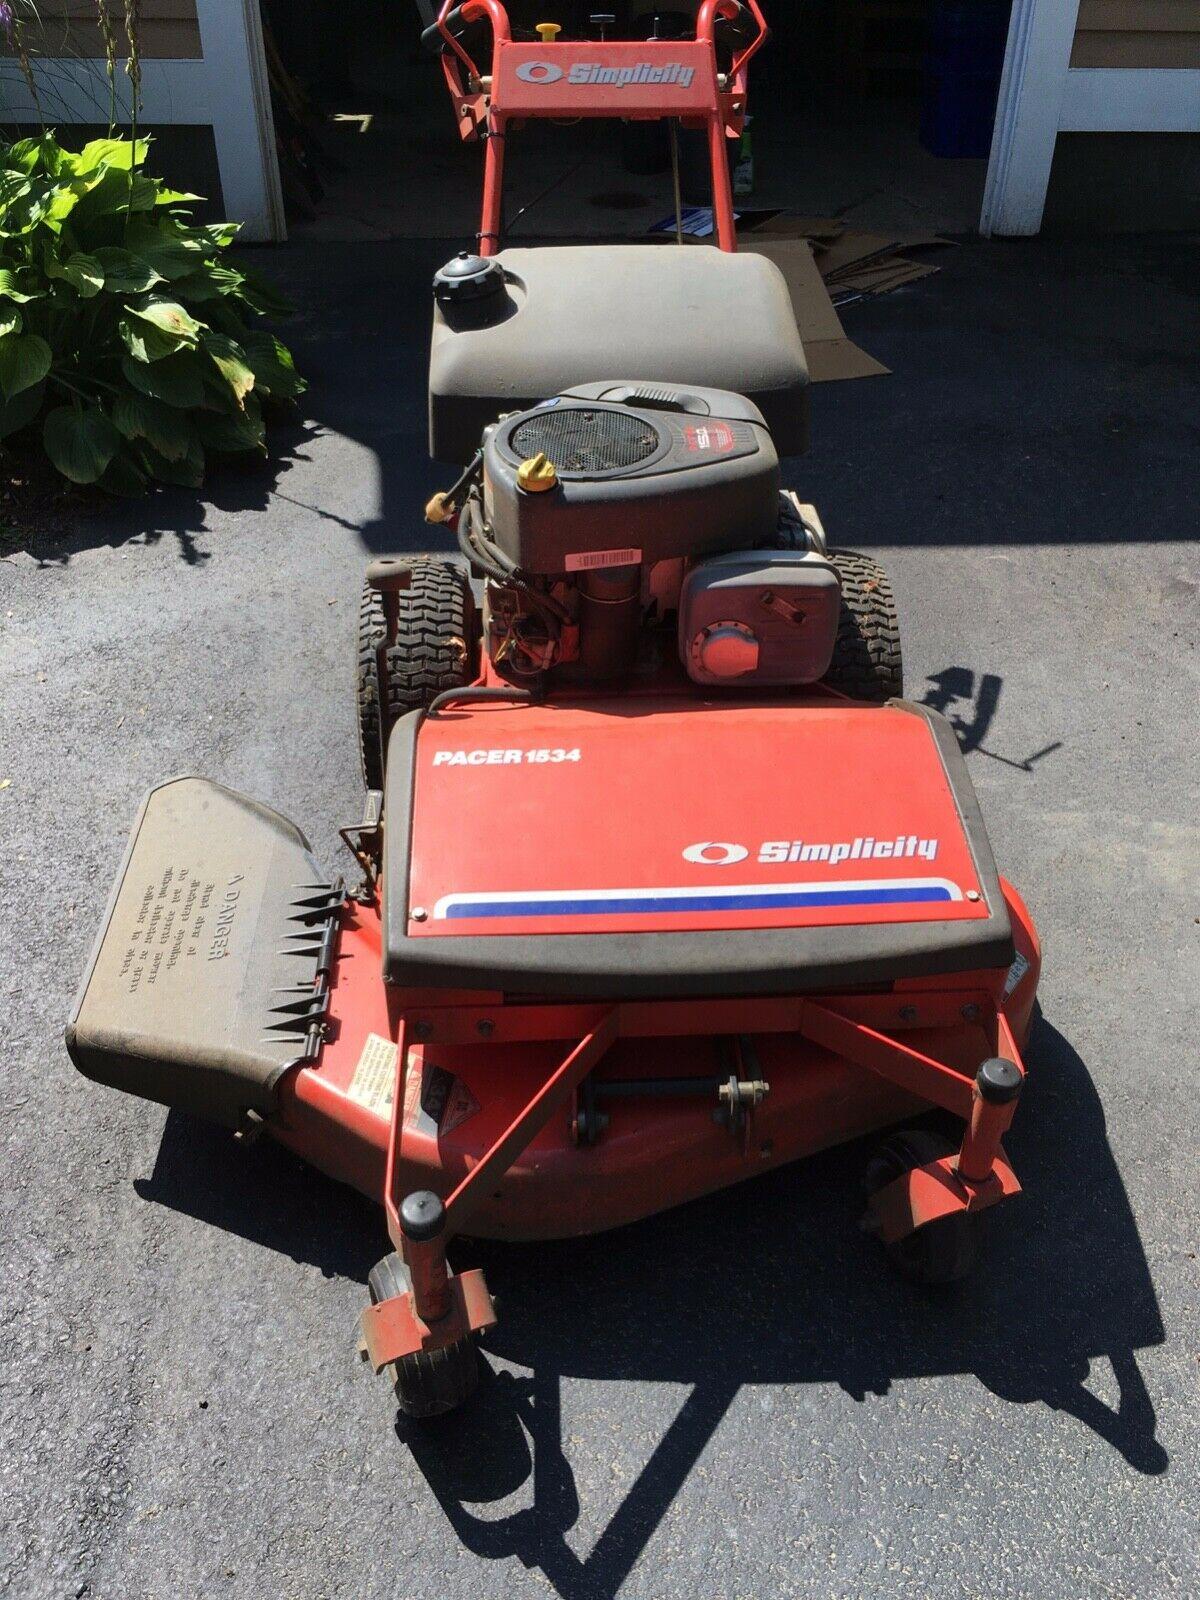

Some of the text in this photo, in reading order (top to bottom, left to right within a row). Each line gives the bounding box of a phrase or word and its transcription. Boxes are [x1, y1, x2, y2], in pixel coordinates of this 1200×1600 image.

[568, 62, 695, 88] Simplicity
[432, 748, 582, 767] PACER 1534
[757, 835, 939, 865] Simplicity
[207, 890, 241, 961] DANGER
